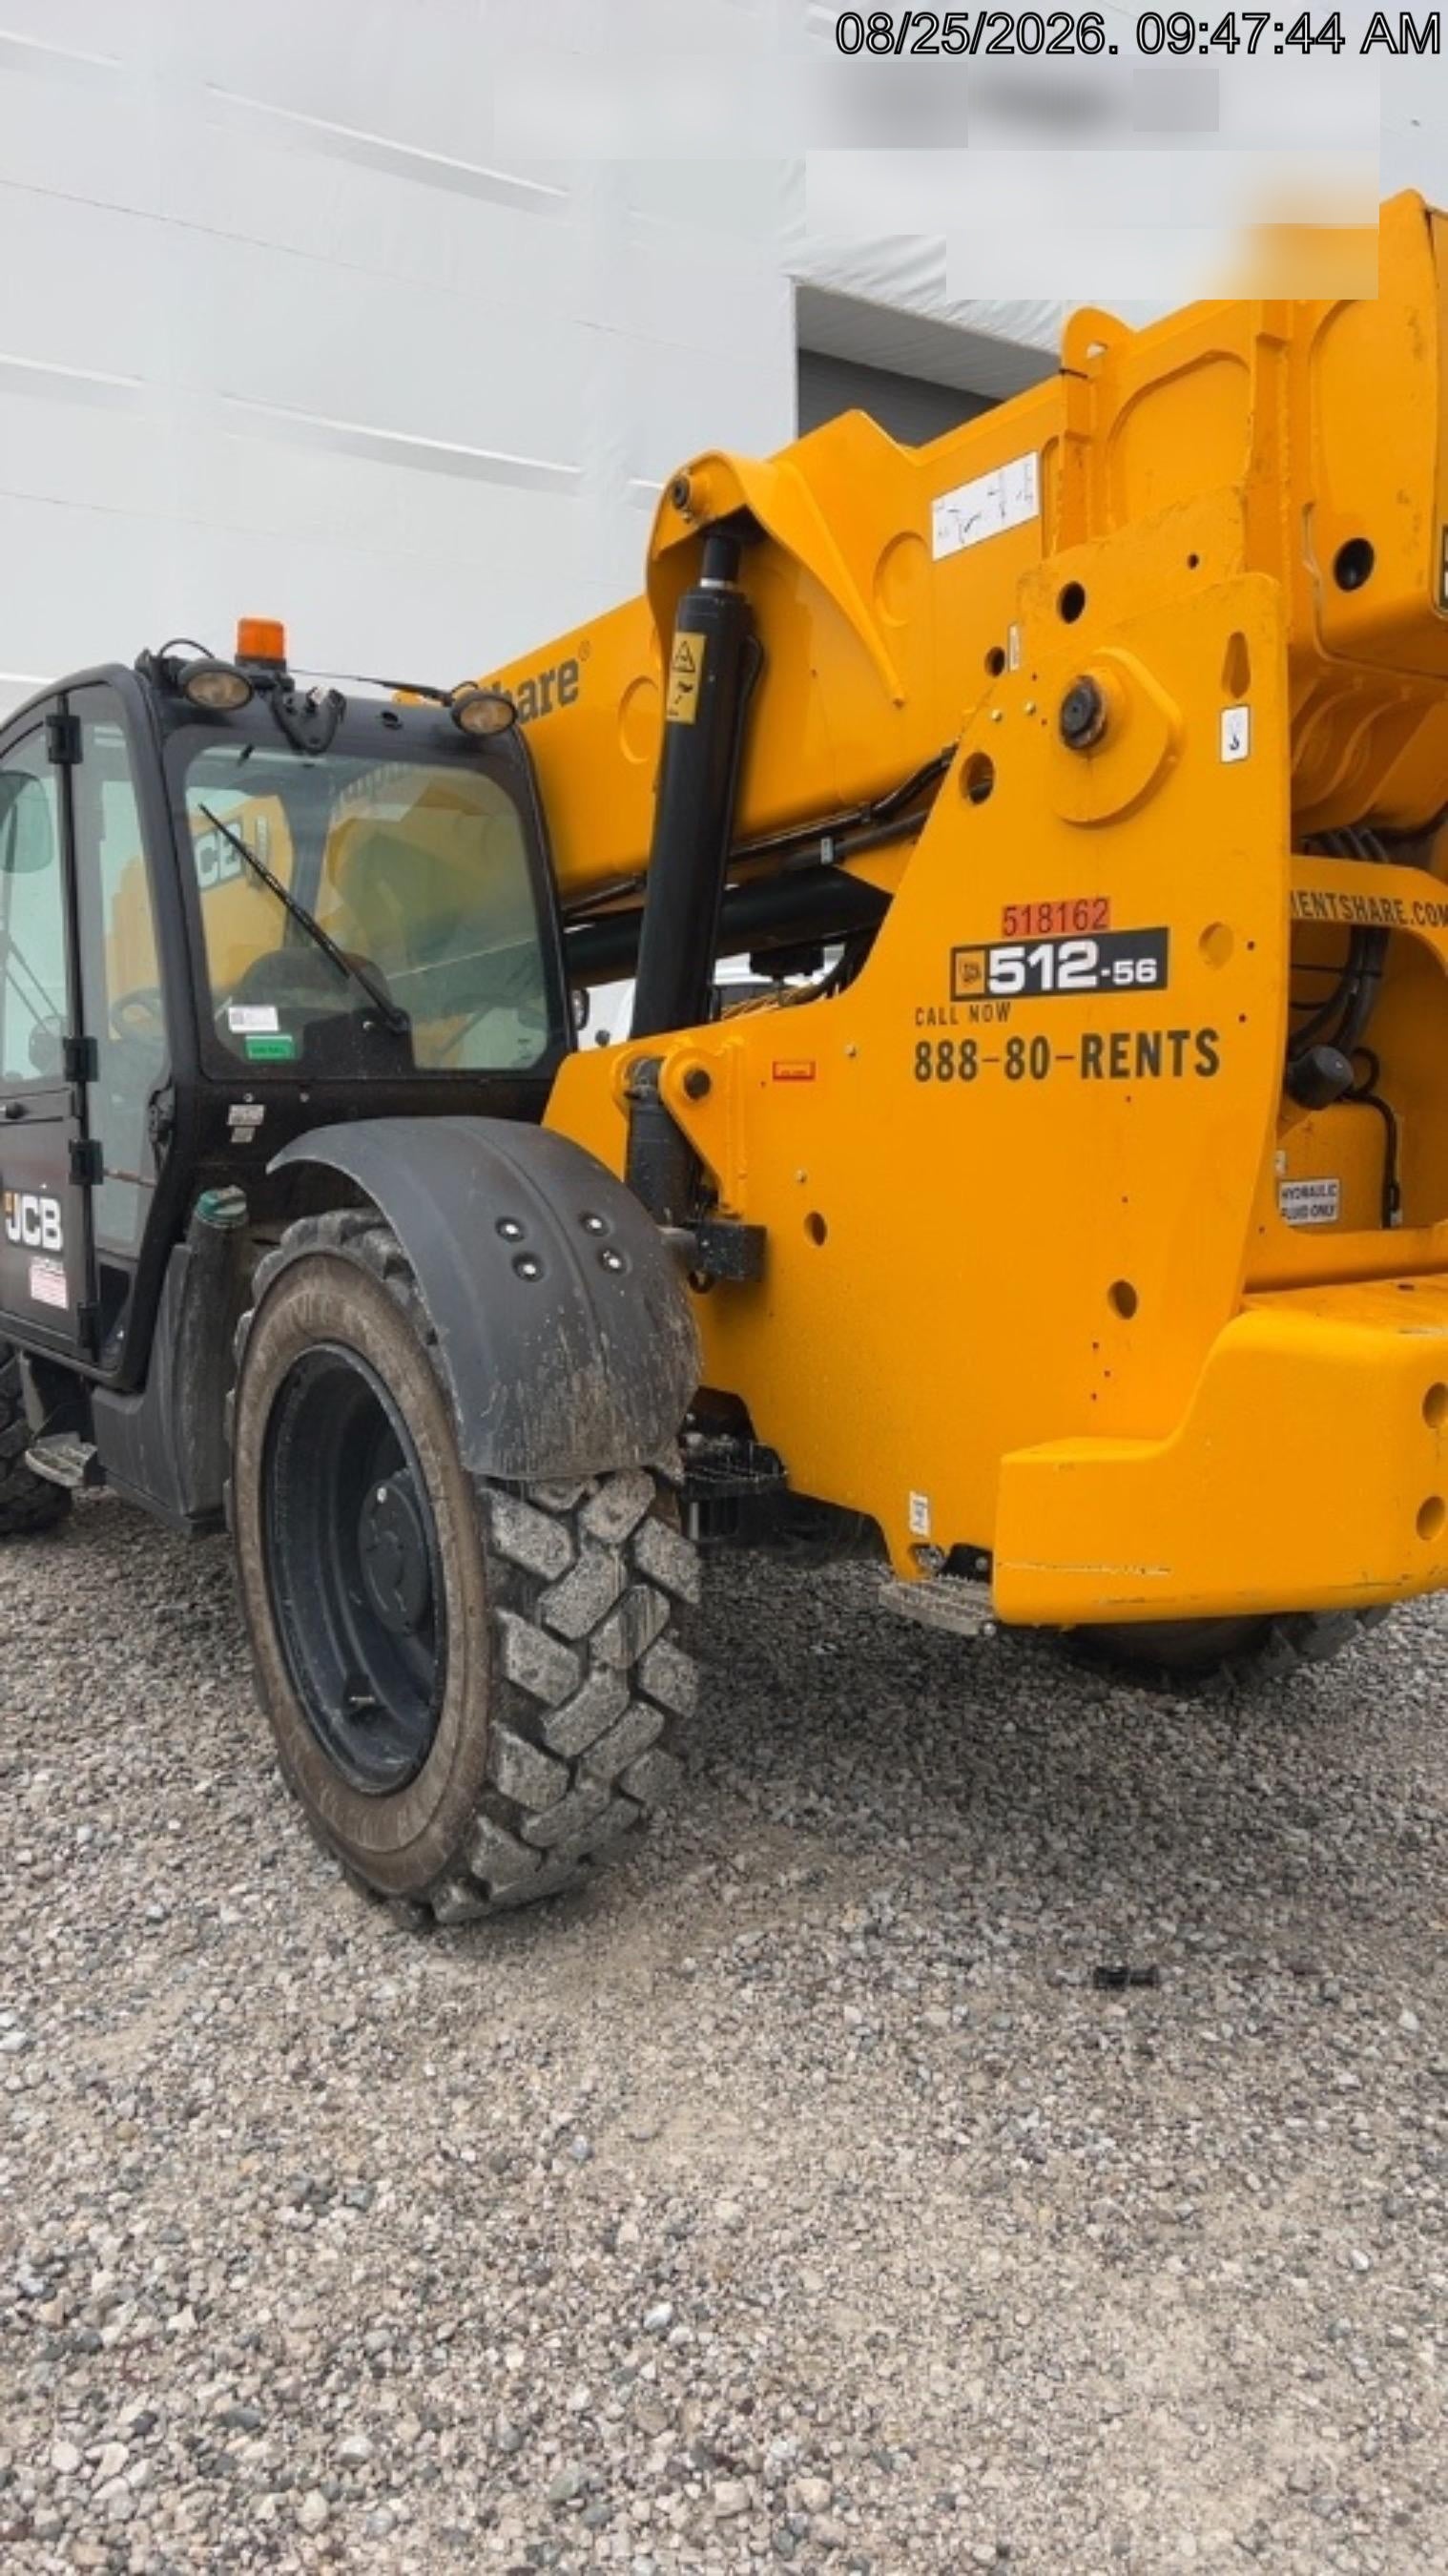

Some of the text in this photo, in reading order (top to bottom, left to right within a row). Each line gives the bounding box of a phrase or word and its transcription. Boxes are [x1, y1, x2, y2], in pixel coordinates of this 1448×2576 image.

[1003, 897, 1109, 937] 518162
[914, 1002, 1011, 1027] CALL NOW
[914, 1028, 1220, 1082] 888-80-RENTS
[5, 1193, 63, 1253] JCB
